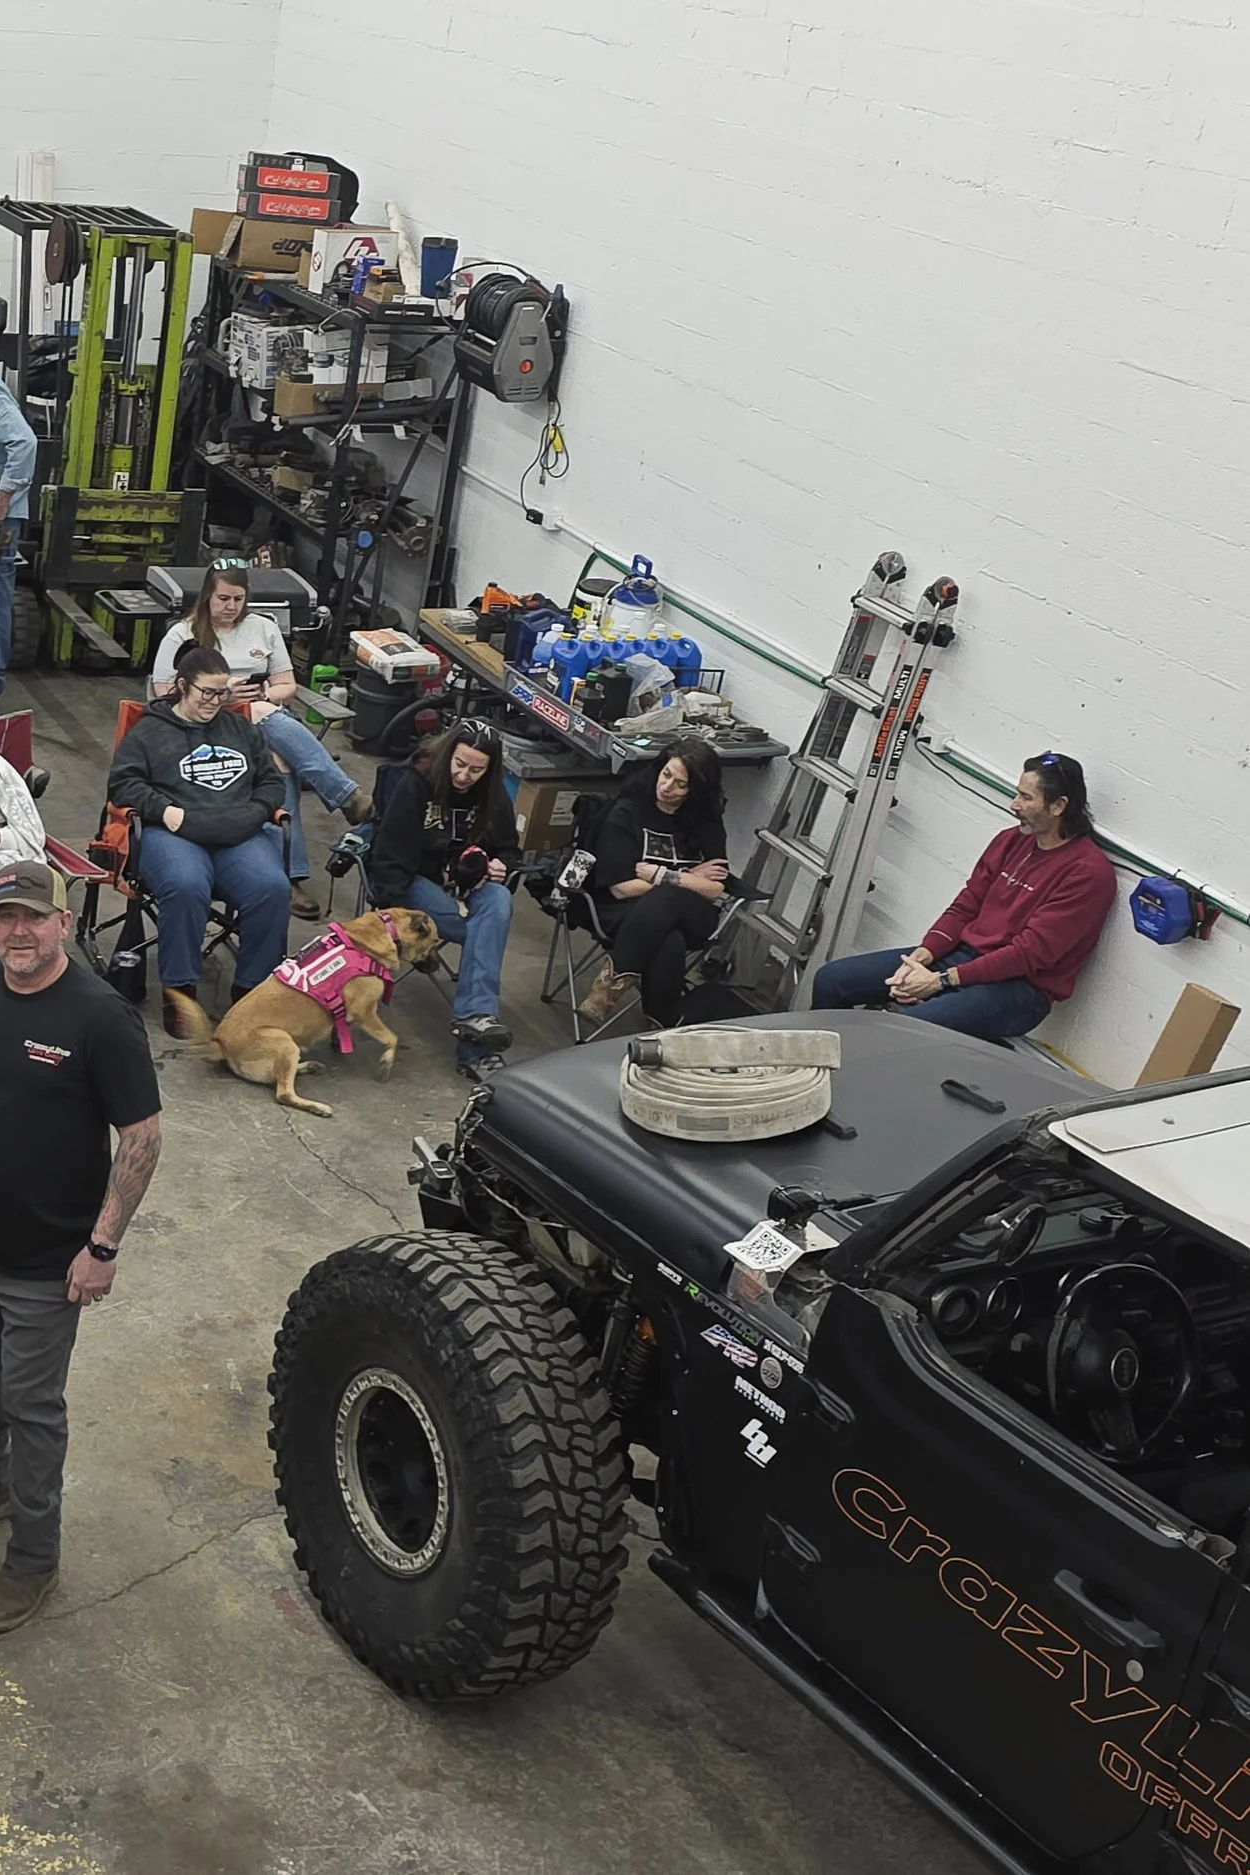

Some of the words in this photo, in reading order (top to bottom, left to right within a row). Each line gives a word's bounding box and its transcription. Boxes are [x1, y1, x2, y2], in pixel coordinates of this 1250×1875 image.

[893, 670, 911, 700] MULTI
[892, 729, 908, 760] MULTI
[684, 1281, 764, 1344] REVOLUTION
